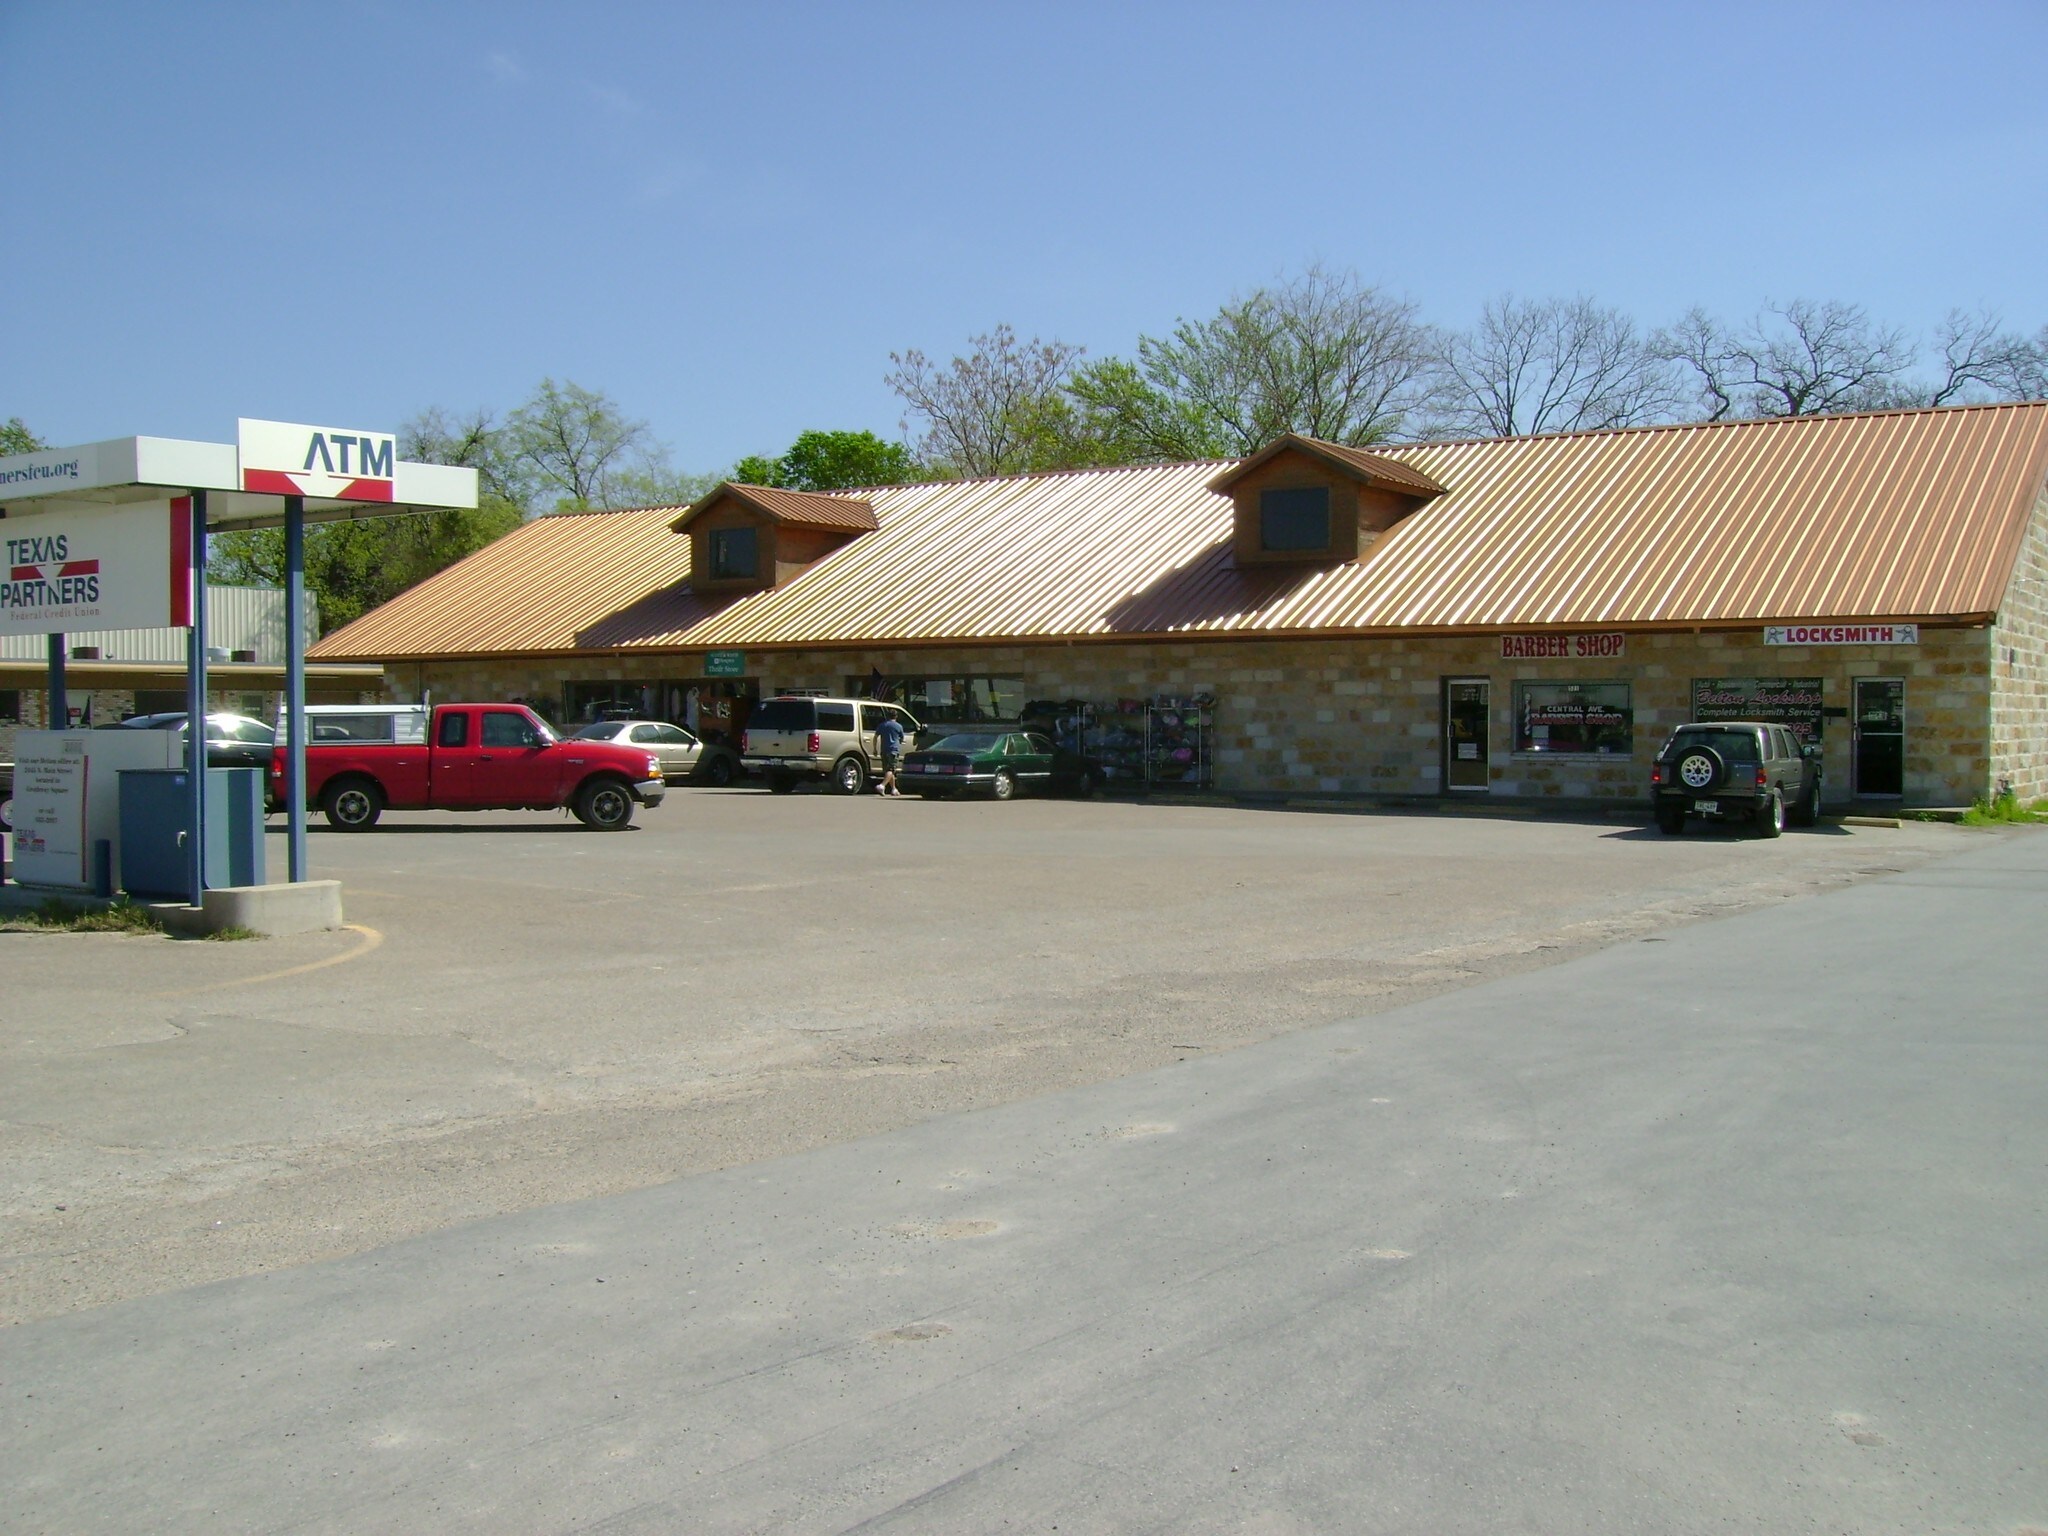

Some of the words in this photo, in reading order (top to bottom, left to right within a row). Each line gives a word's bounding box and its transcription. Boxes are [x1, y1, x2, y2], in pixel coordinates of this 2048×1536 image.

[303, 432, 394, 478] ATM
[7, 534, 68, 565] TEXAS
[0, 576, 99, 608] PARTNERS
[10, 610, 41, 621] Federal
[44, 608, 71, 619] Credit
[74, 606, 100, 617] Union
[1786, 627, 1893, 643] LOCKSMITH
[1502, 636, 1569, 657] BARBER
[1576, 634, 1623, 657] SHOP
[1696, 688, 1745, 705] Belton
[1748, 688, 1822, 707] Lockshop
[1546, 705, 1584, 713] CENTRAL
[1587, 705, 1605, 713] AVE.
[1697, 707, 1738, 717] Complete
[1739, 707, 1785, 717] Locksmith
[1787, 707, 1821, 717] Service
